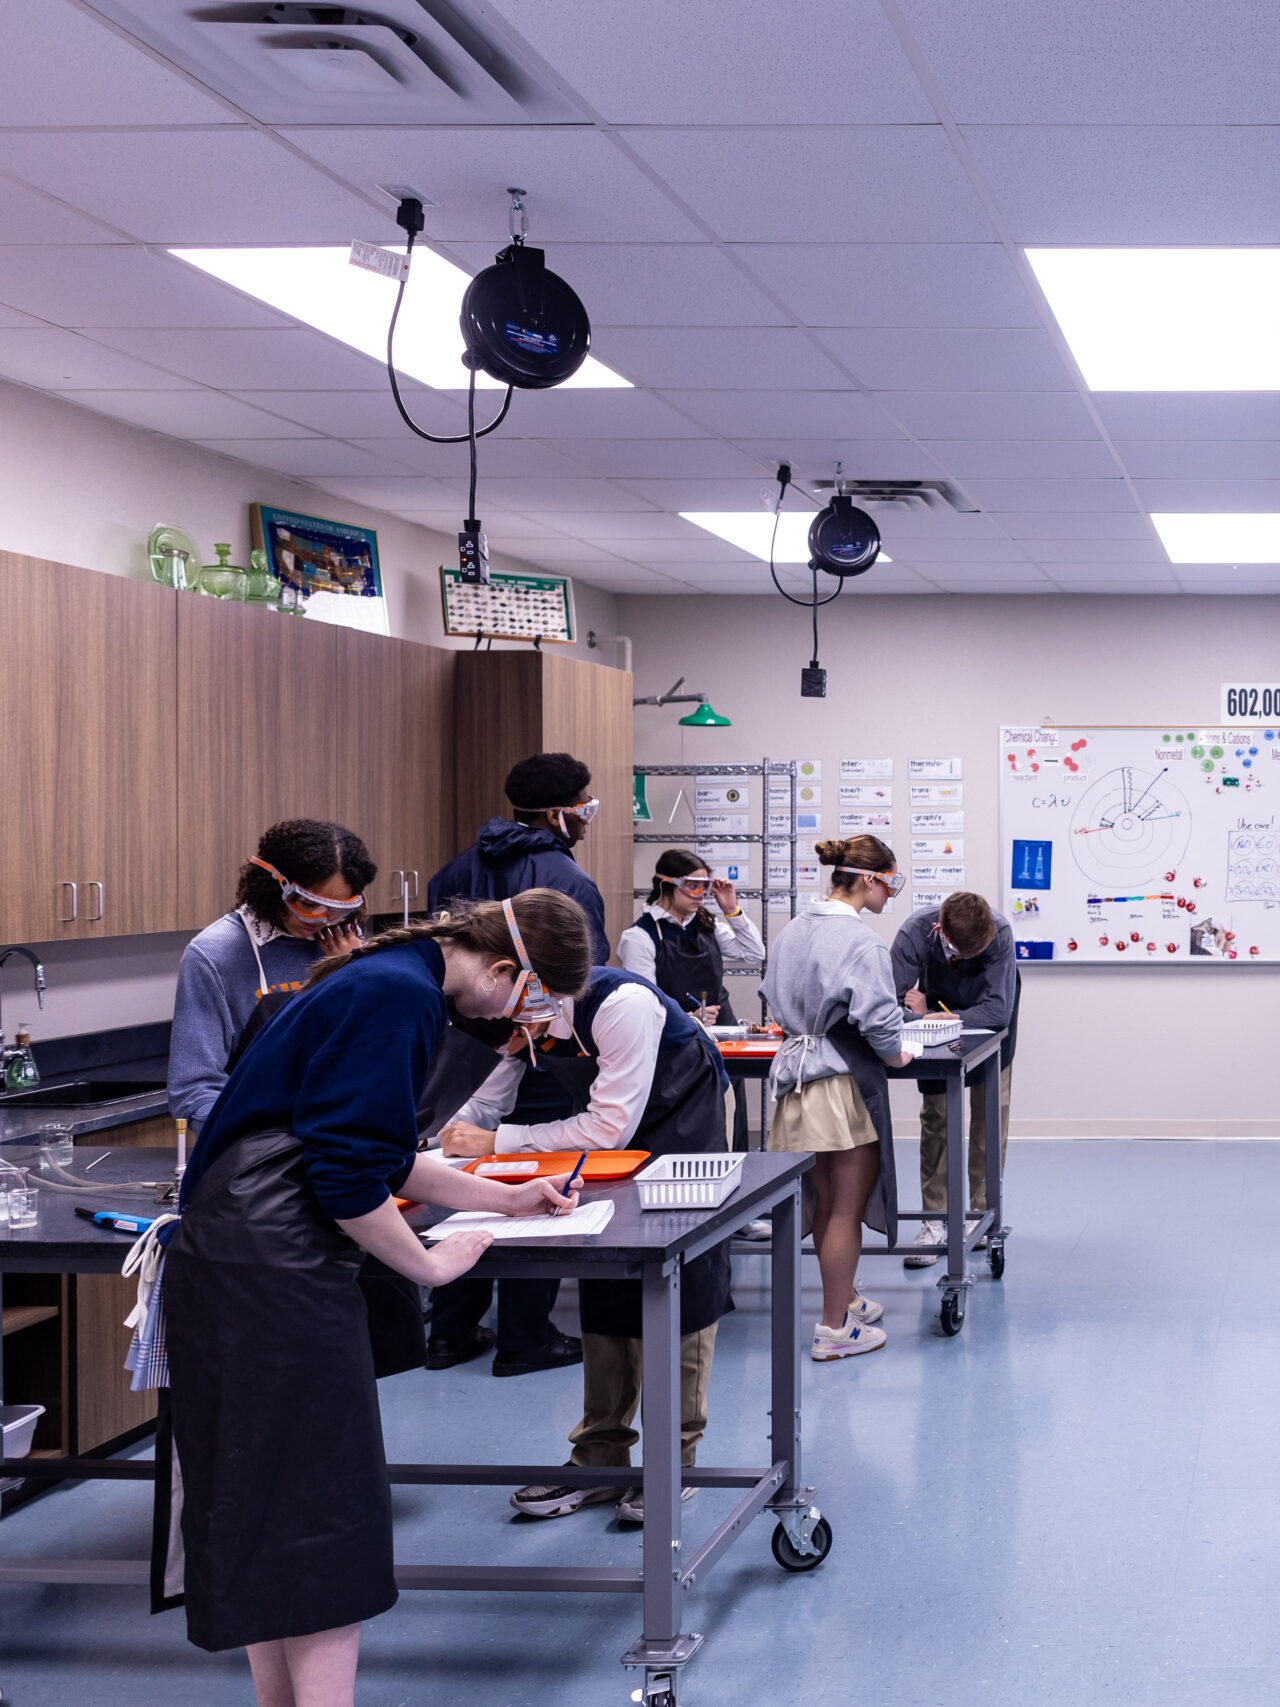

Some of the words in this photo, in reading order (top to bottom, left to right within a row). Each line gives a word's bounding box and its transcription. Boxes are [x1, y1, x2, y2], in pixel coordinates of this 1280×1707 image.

[1005, 730, 1033, 743] Chemical
[1228, 732, 1251, 744] Cations
[1155, 748, 1183, 760] Nonmetal
